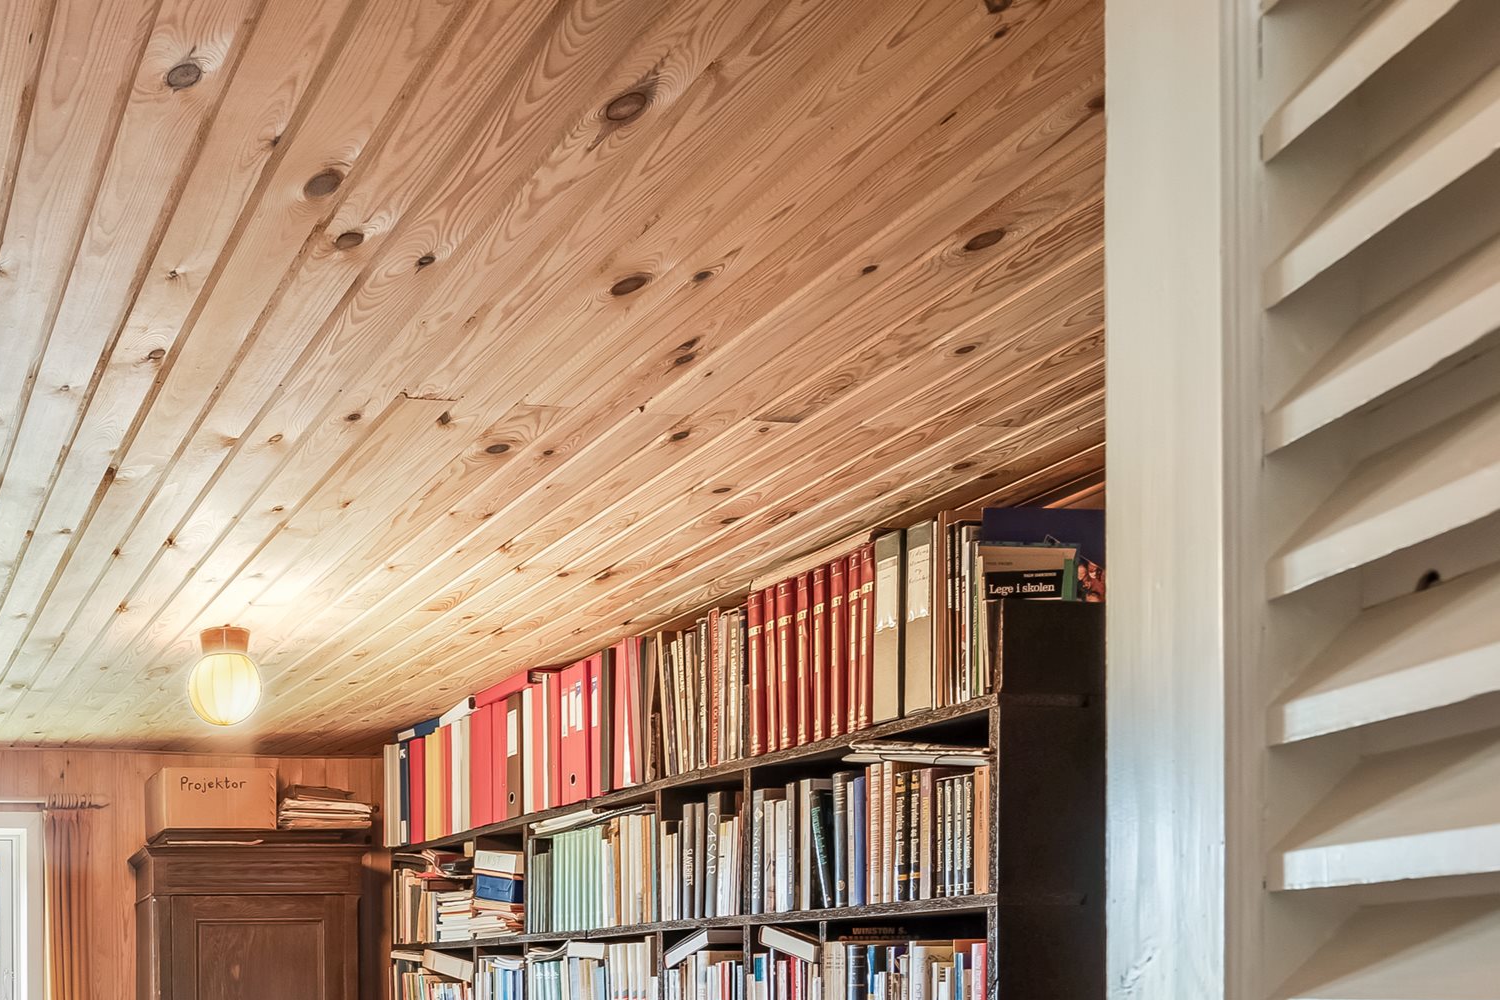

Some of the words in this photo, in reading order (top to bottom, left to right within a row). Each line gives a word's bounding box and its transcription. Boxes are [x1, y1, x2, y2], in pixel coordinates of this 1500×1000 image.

[989, 584, 1014, 595] Lege
[1016, 583, 1020, 593] i
[1022, 582, 1055, 593] skolen
[180, 776, 247, 793] Projektor
[707, 812, 717, 875] CÆSAR
[753, 826, 761, 899] NAPOLEON
[852, 927, 894, 935] WINSTON
